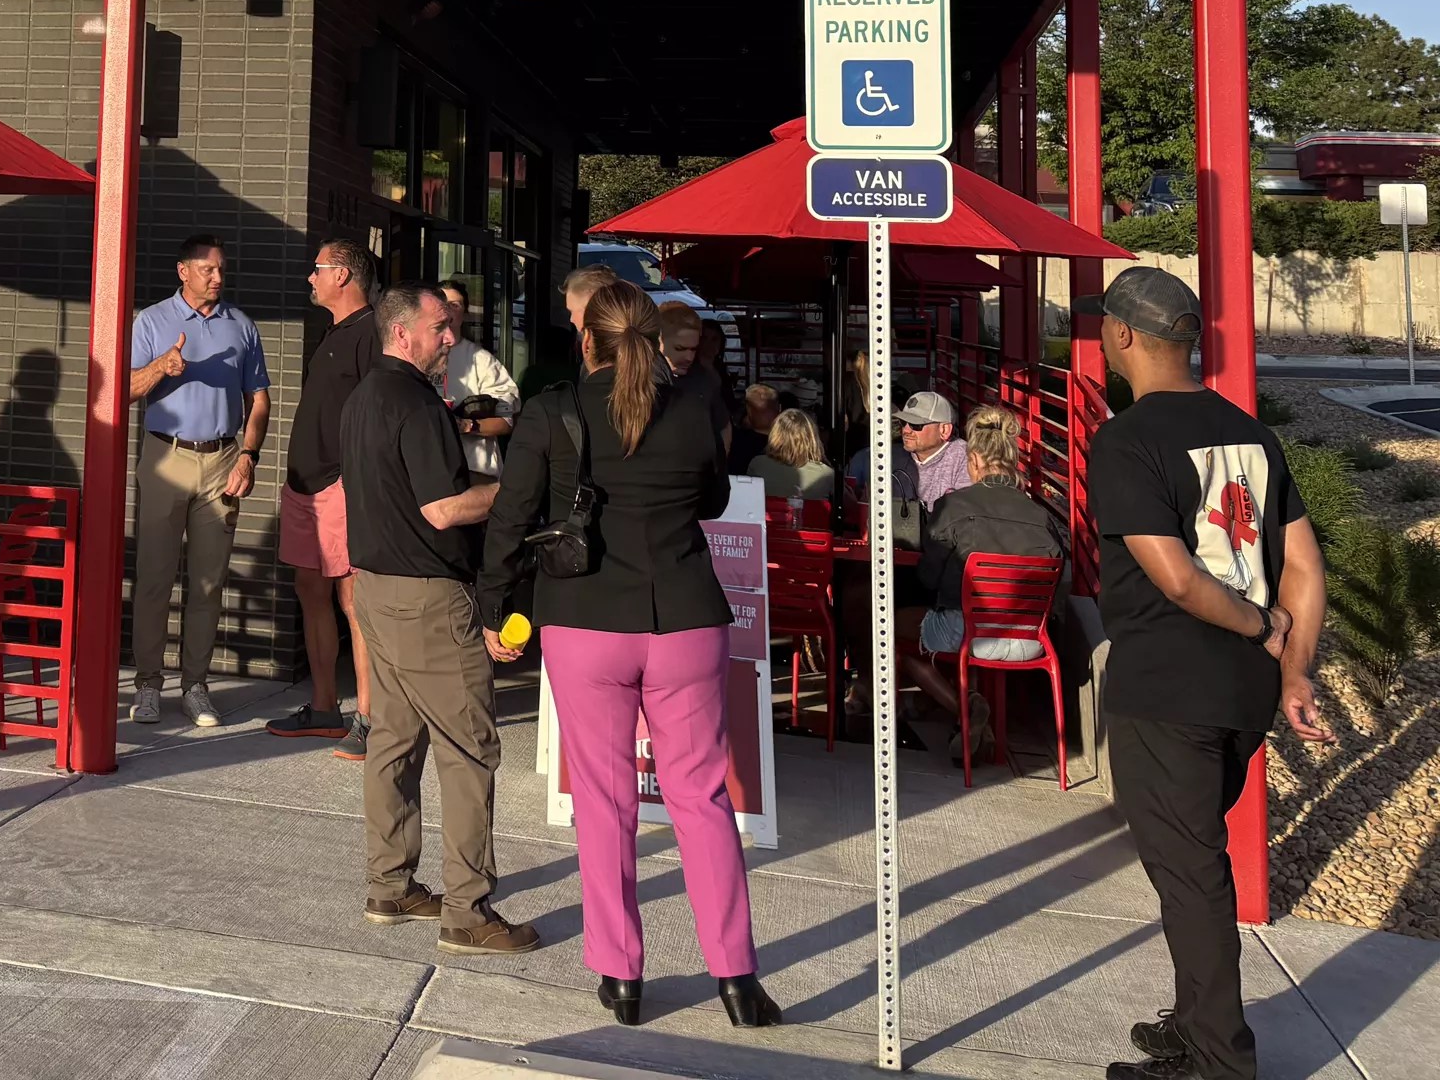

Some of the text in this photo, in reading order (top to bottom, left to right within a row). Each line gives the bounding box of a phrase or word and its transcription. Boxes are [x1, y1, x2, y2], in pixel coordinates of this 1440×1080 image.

[825, 19, 929, 43] PARKING
[855, 170, 902, 189] VAN
[831, 192, 927, 207] ACCESSIBLE
[713, 534, 737, 547] EVENT
[739, 536, 754, 548] FOR
[714, 545, 721, 556] &
[722, 546, 750, 559] FAMILY
[741, 605, 757, 618] FOR
[729, 617, 753, 630] MILY
